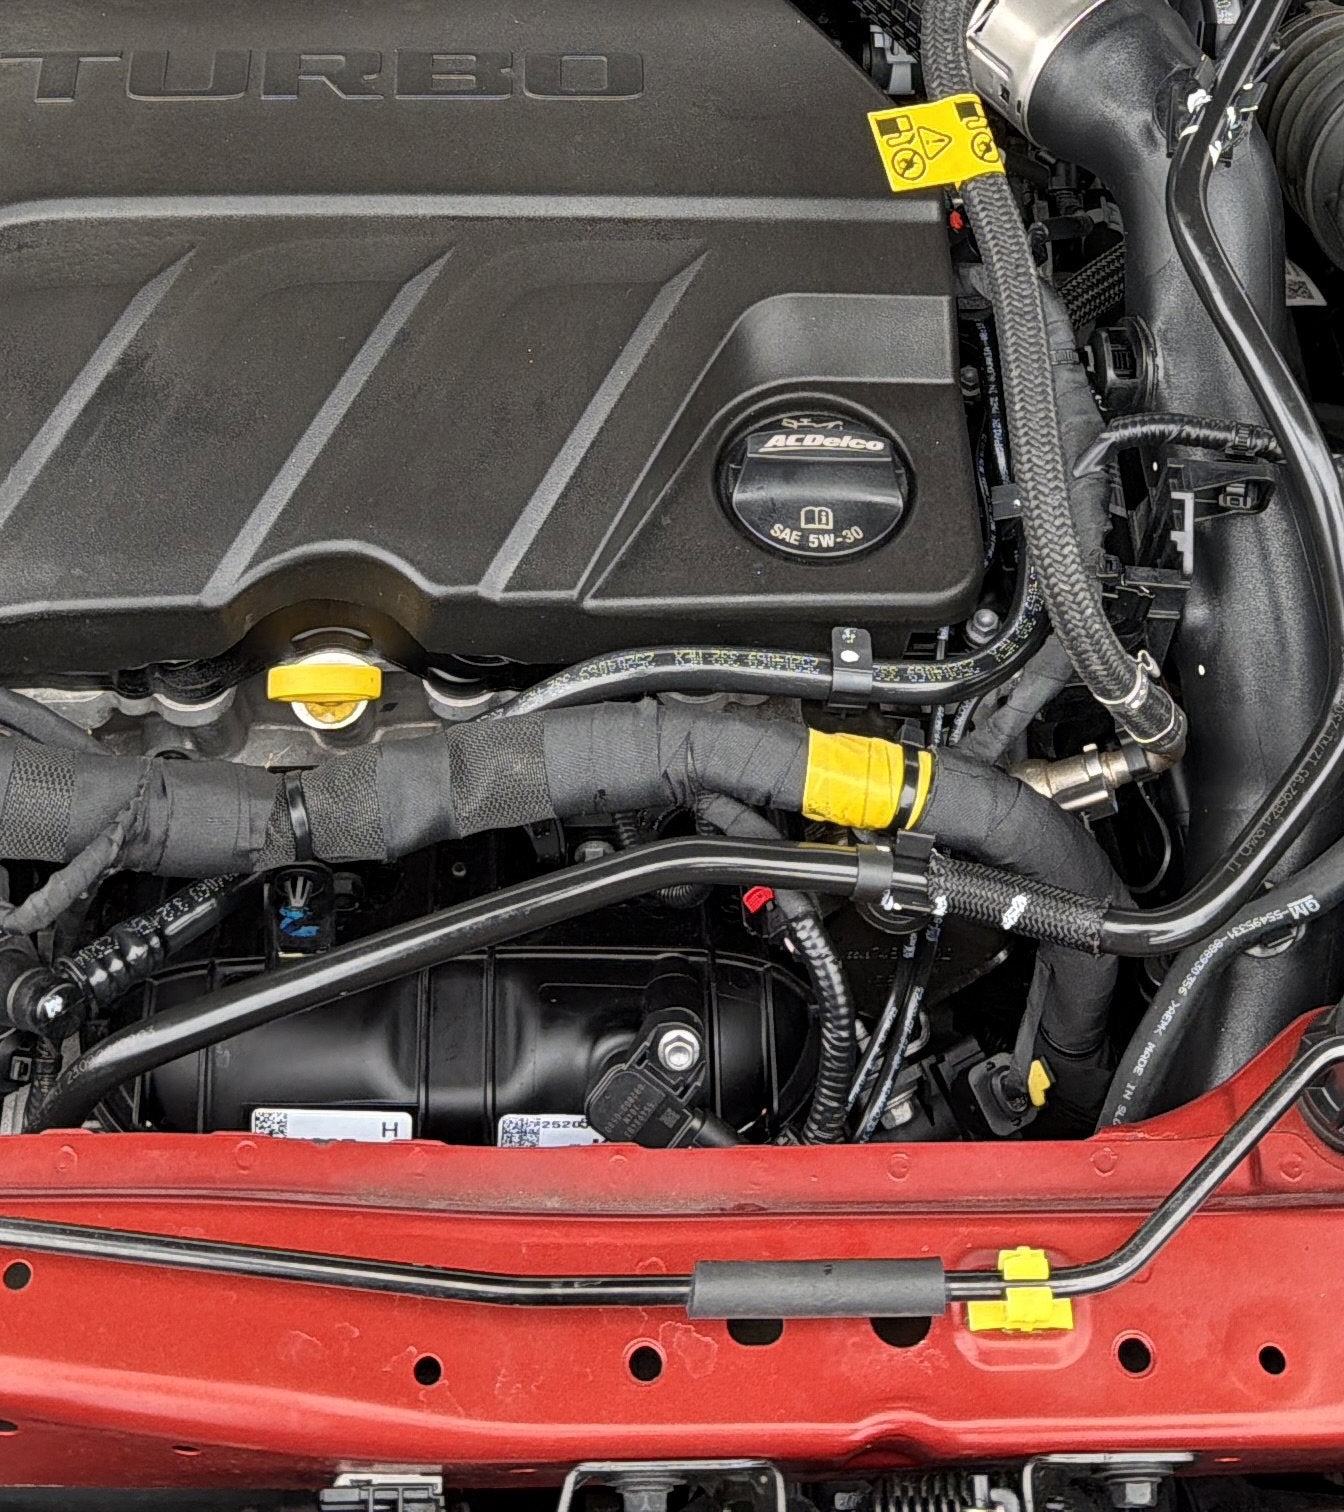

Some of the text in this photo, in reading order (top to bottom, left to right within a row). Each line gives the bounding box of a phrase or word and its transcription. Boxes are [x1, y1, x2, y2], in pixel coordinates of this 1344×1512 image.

[0, 50, 646, 103] TURBO
[763, 434, 885, 451] ACDelco
[770, 524, 864, 548] SAE 5W-30
[1133, 1042, 1156, 1076] MADE
[1123, 1083, 1136, 1100] IN
[381, 1122, 398, 1138] H
